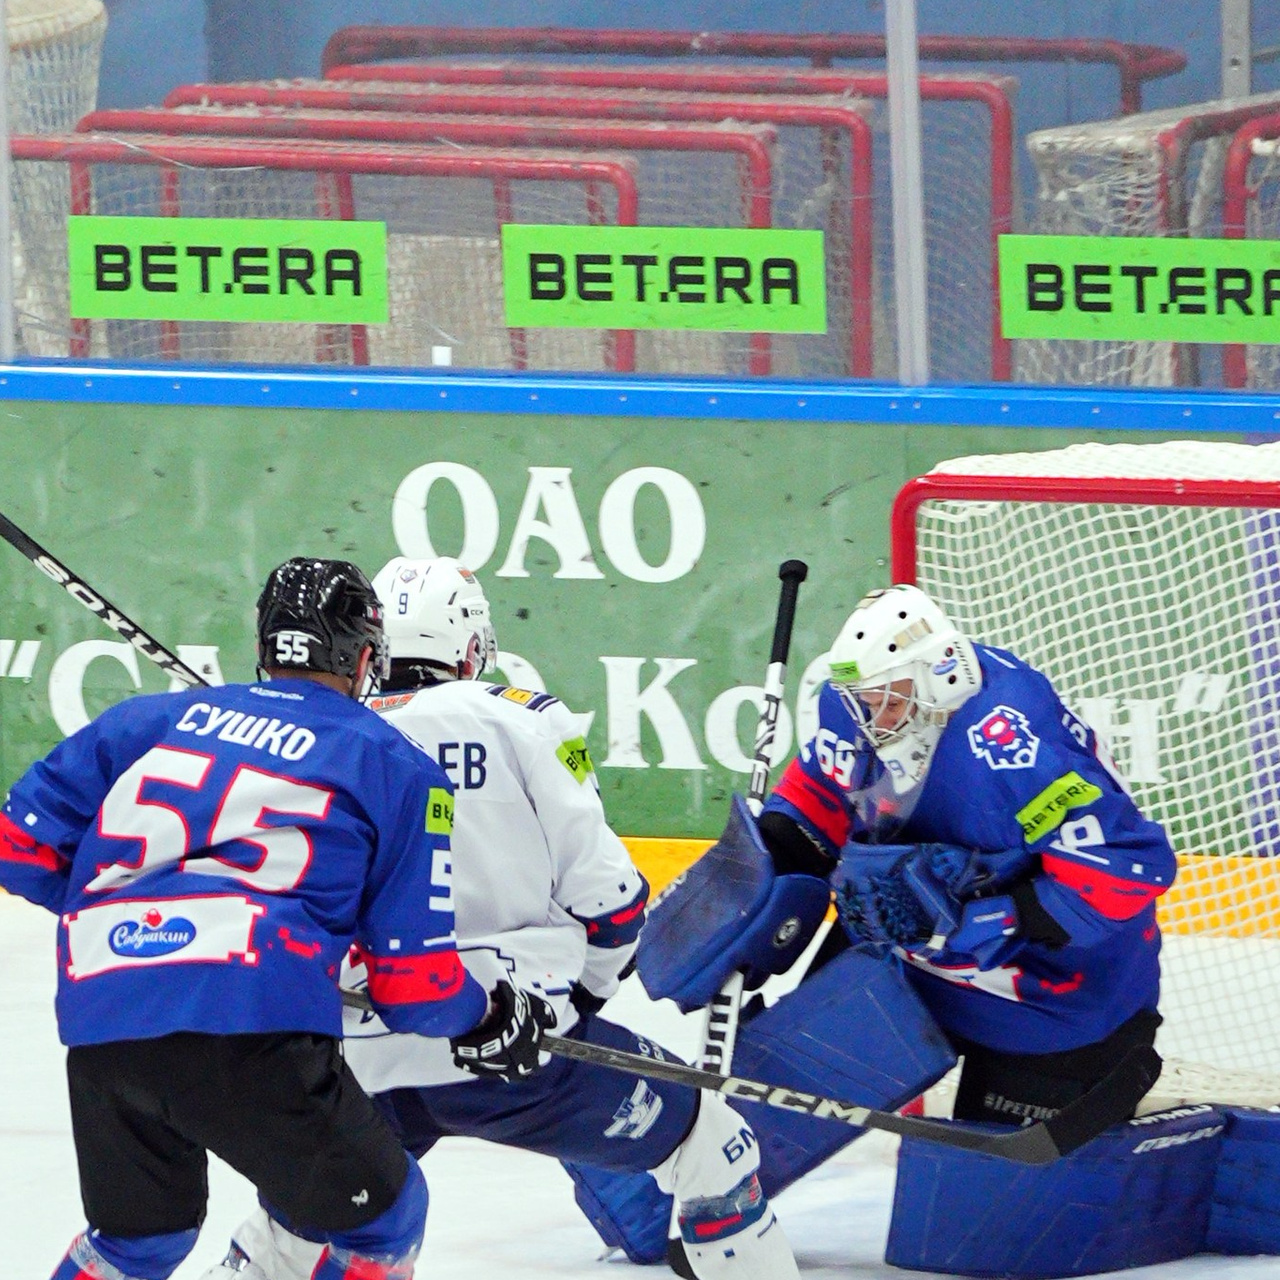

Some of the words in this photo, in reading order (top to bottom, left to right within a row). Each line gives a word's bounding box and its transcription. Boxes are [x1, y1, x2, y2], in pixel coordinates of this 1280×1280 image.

[393, 461, 707, 584] ОАО
[275, 634, 310, 664] 55
[175, 702, 317, 761] СУШКО
[815, 728, 857, 789] 69
[83, 744, 335, 895] 55
[720, 1077, 872, 1127] CCM
